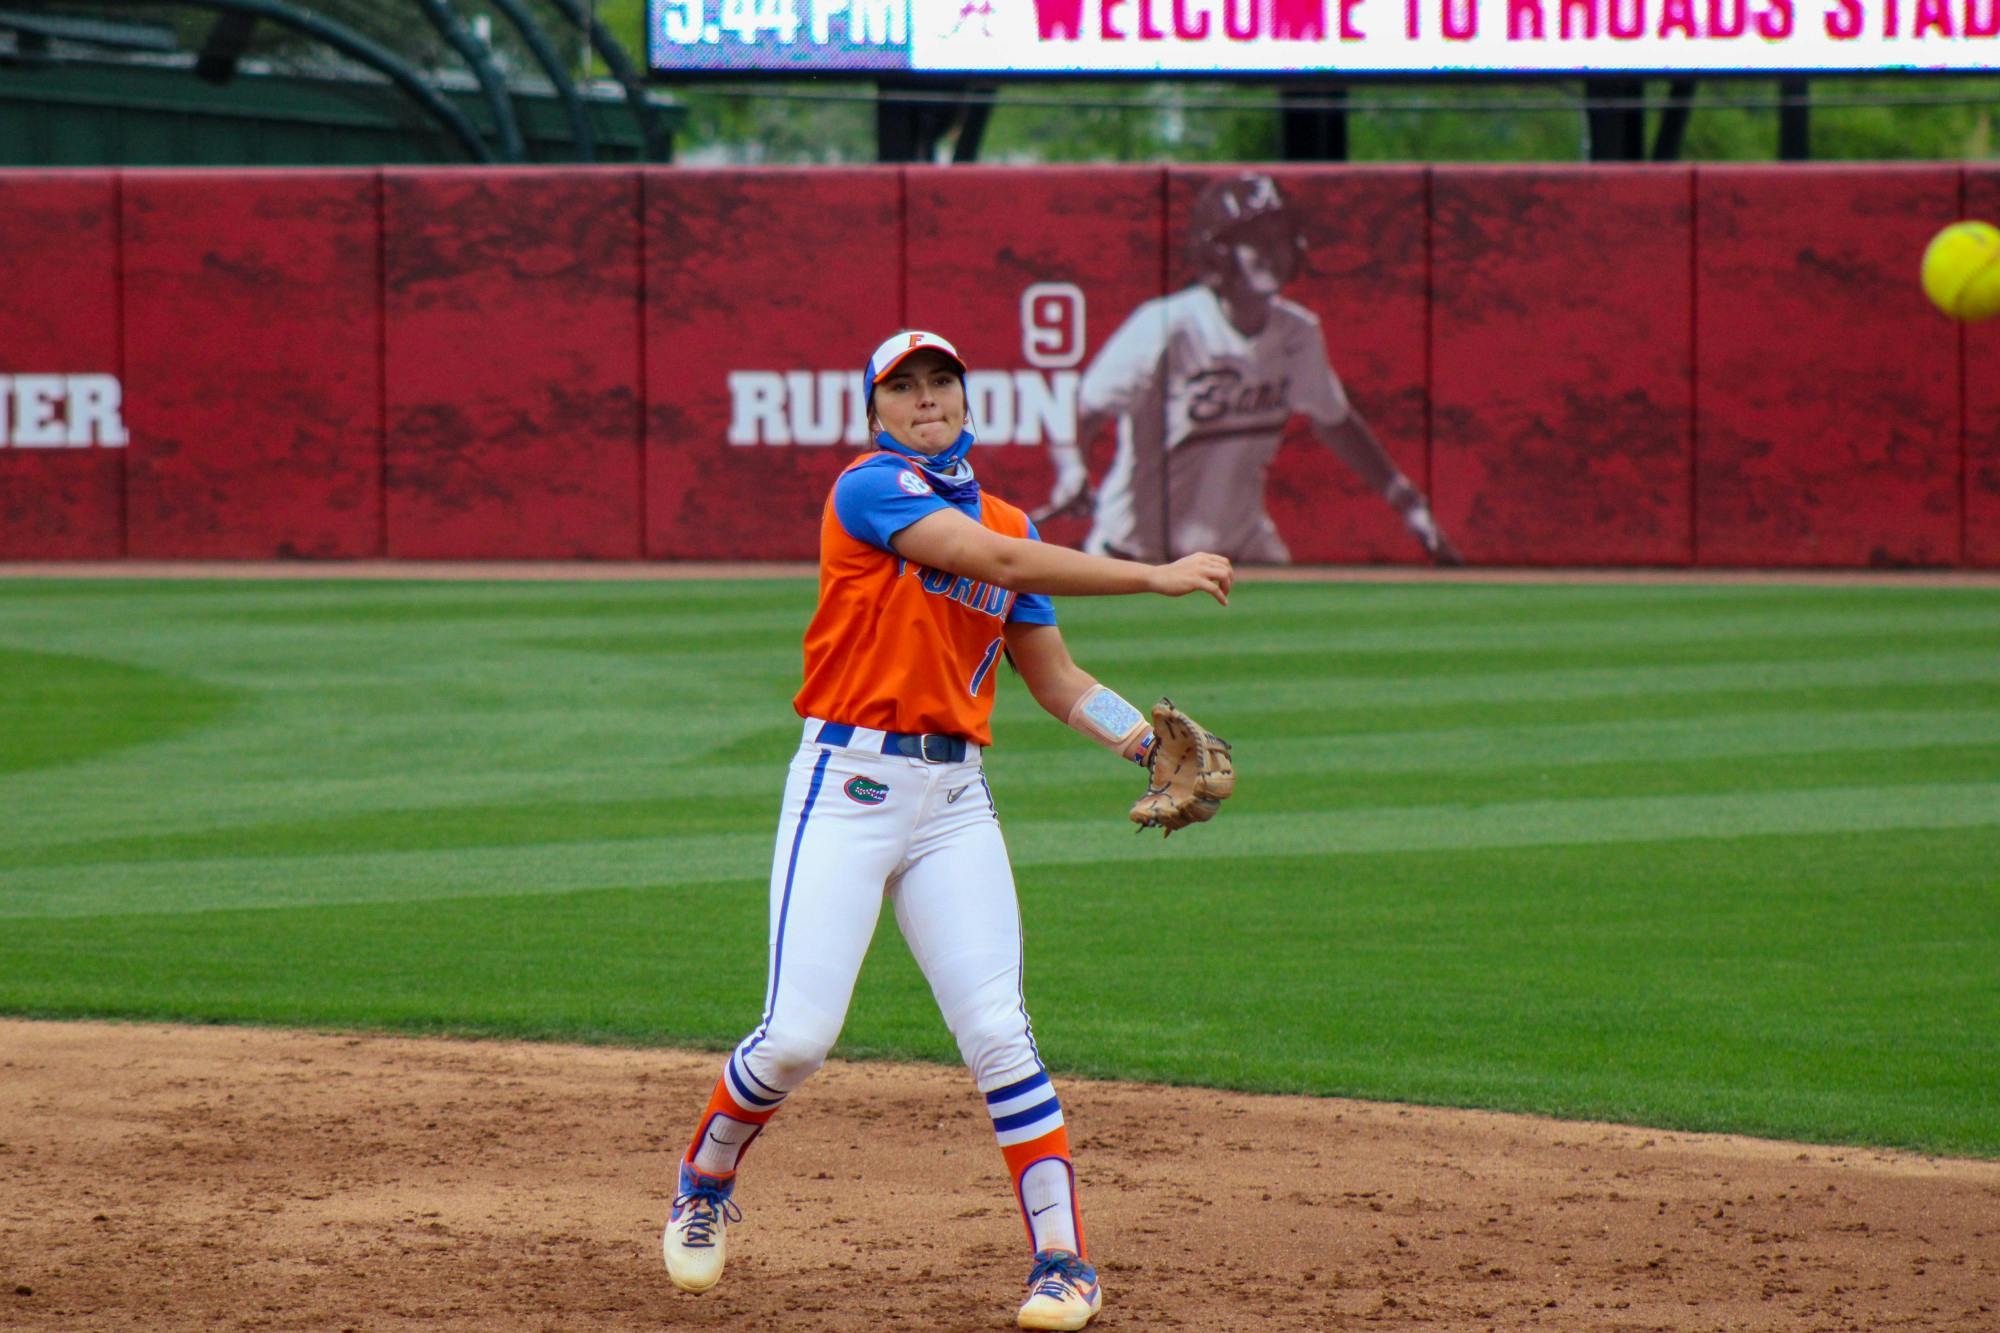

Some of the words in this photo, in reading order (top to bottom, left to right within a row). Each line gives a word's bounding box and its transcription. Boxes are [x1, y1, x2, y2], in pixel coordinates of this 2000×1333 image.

[909, 334, 925, 347] F
[1022, 282, 1086, 368] 9
[0, 373, 130, 448] ER
[727, 371, 1080, 446] RUON
